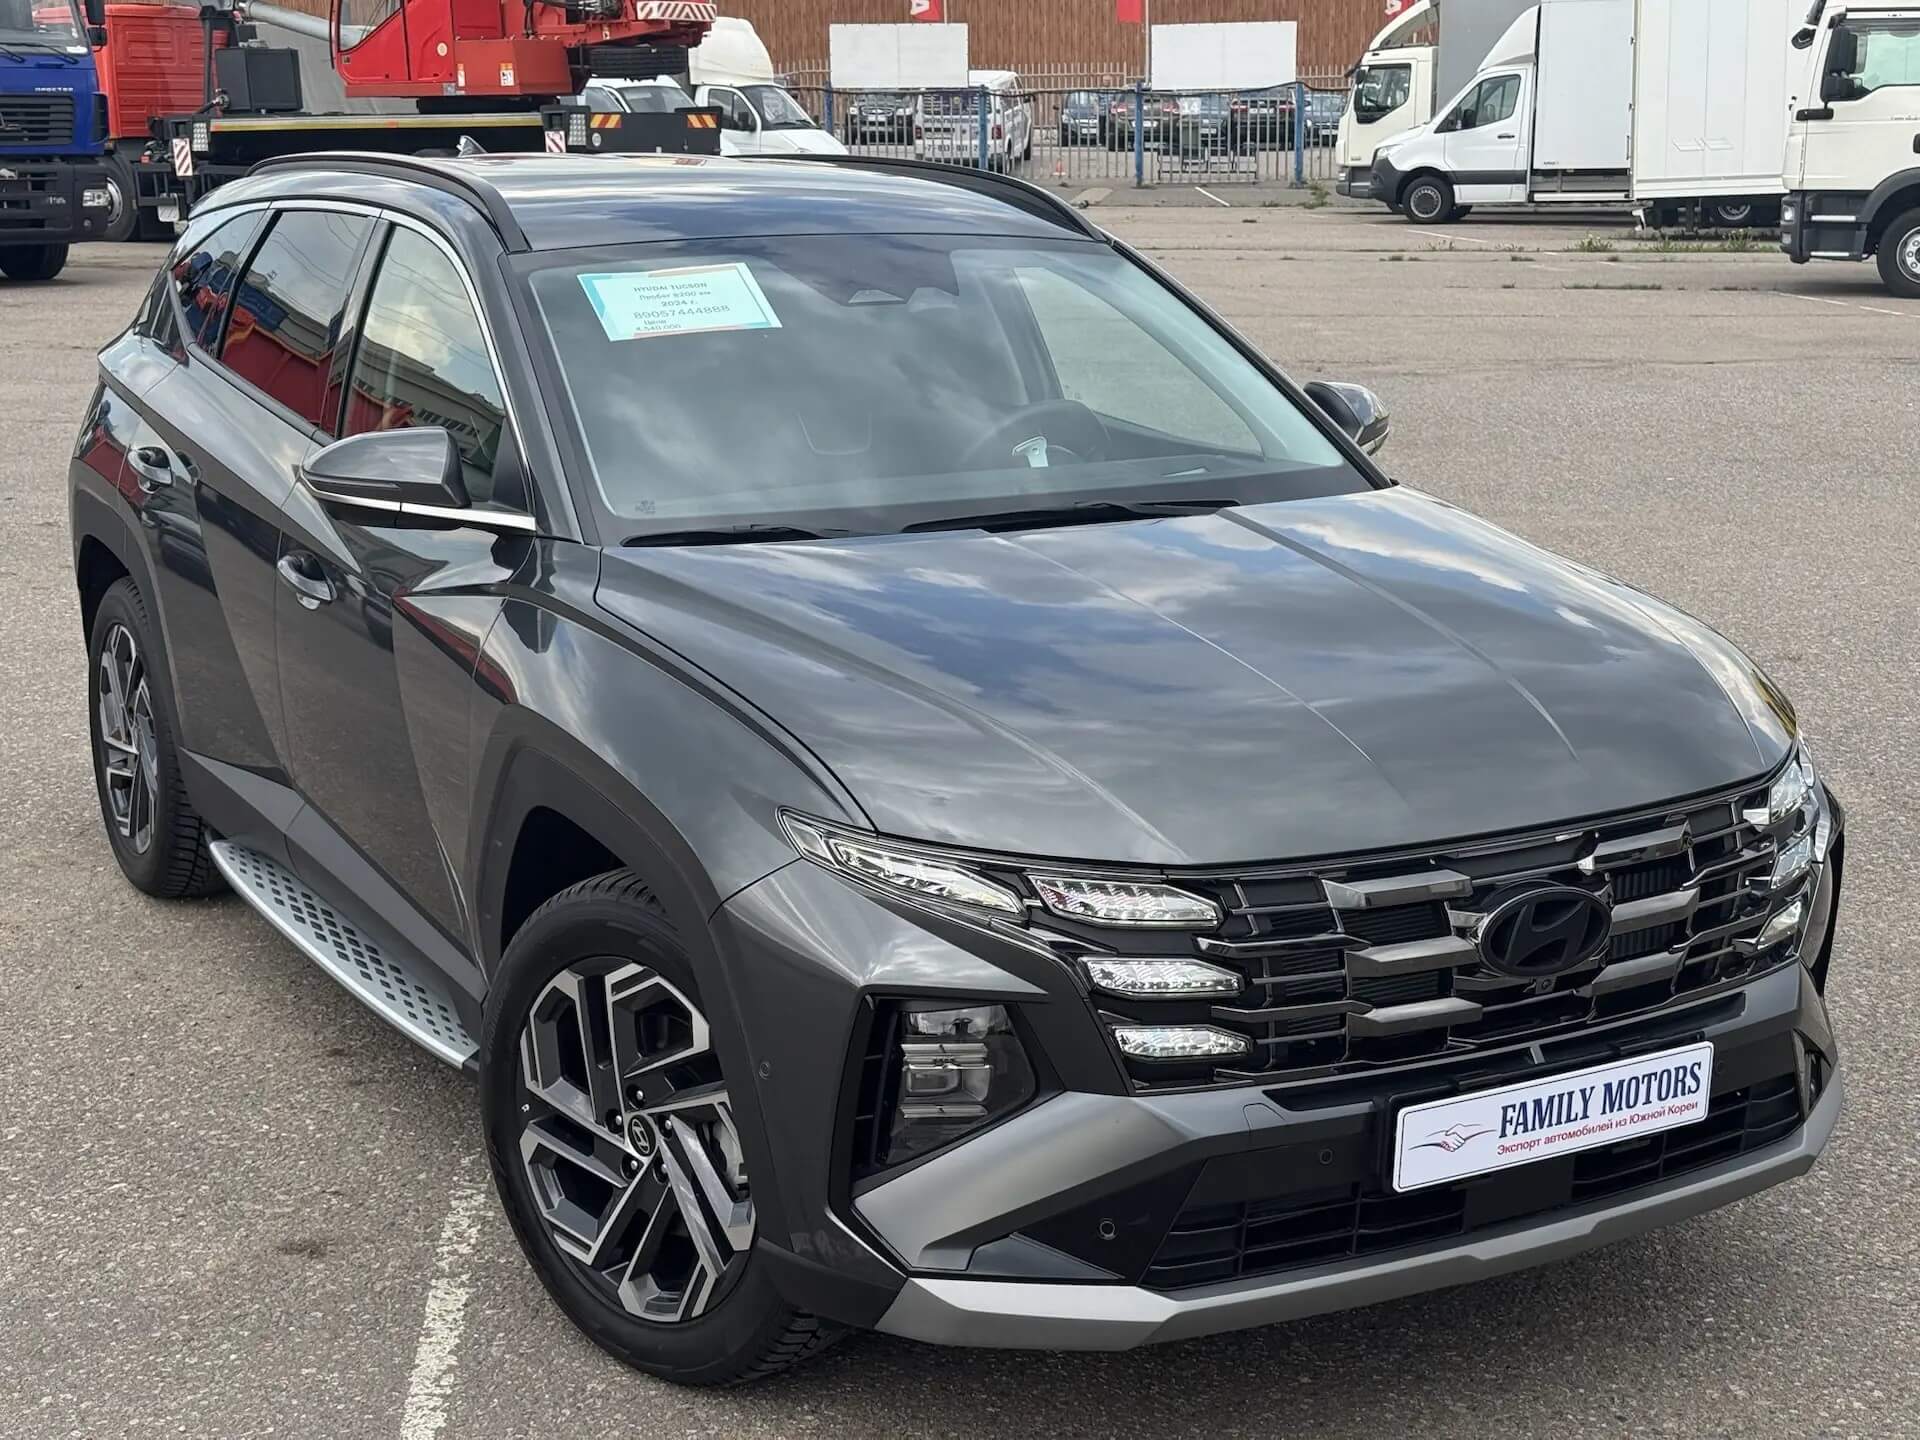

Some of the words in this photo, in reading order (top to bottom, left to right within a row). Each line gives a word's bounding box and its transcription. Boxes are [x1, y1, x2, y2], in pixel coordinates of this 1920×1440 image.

[670, 282, 708, 290] TUCSON
[1499, 1086, 1596, 1138] FAMILY
[1600, 1062, 1701, 1115] MOTORS
[1497, 1136, 1542, 1156] Экспорт
[1544, 1119, 1613, 1145] автомобилей
[1615, 1118, 1627, 1129] из
[1628, 1106, 1666, 1127] Южной
[1668, 1101, 1698, 1117] Кореи
